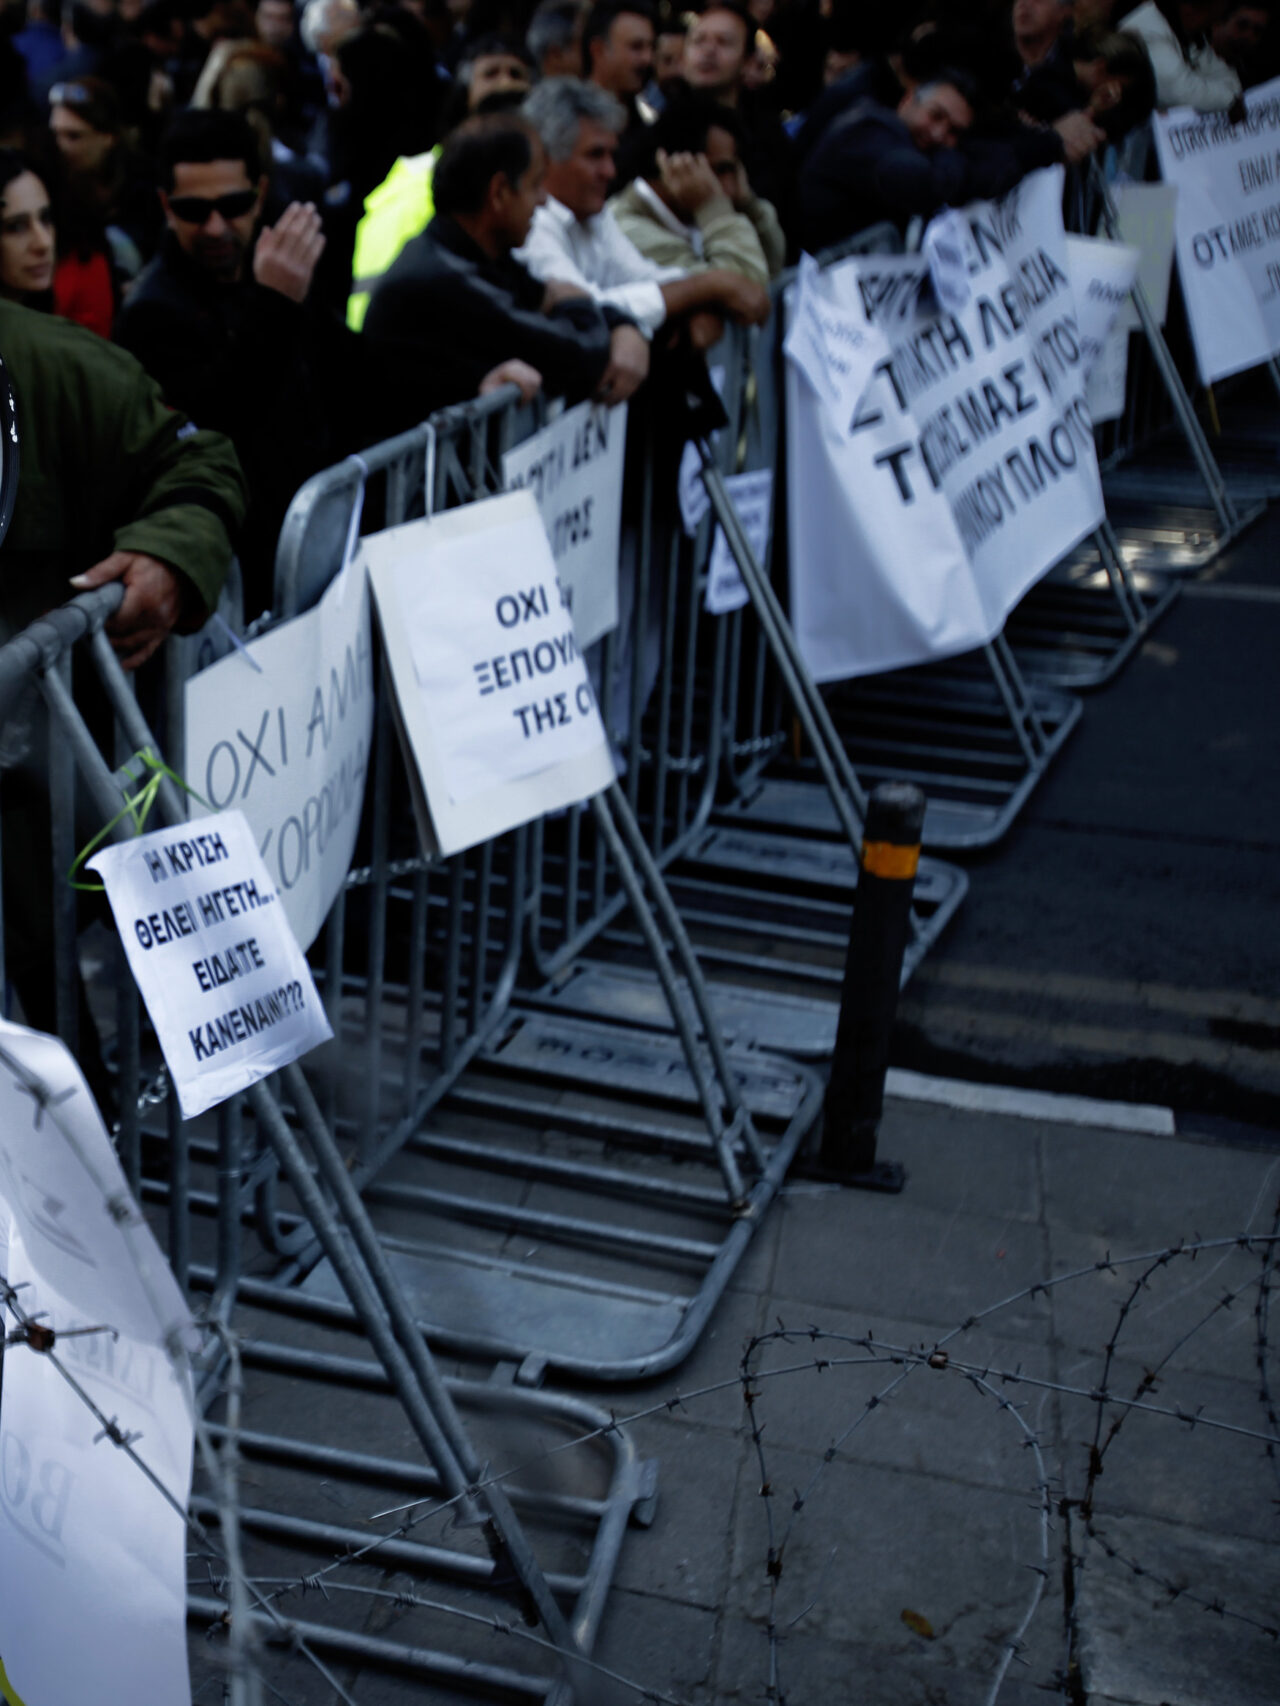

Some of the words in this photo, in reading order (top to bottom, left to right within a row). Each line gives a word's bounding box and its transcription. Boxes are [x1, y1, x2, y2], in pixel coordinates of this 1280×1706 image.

[496, 584, 549, 629] ΟΧΙ
[513, 692, 572, 739] ΤΗΣ
[206, 706, 288, 811] ΟΧΙ
[142, 849, 169, 884] Η
[163, 832, 230, 877] ΚΡΙΣΗ
[134, 899, 200, 951] ΘΕΛΕΙ
[192, 938, 266, 993] ΕΙΔΑΤΕ
